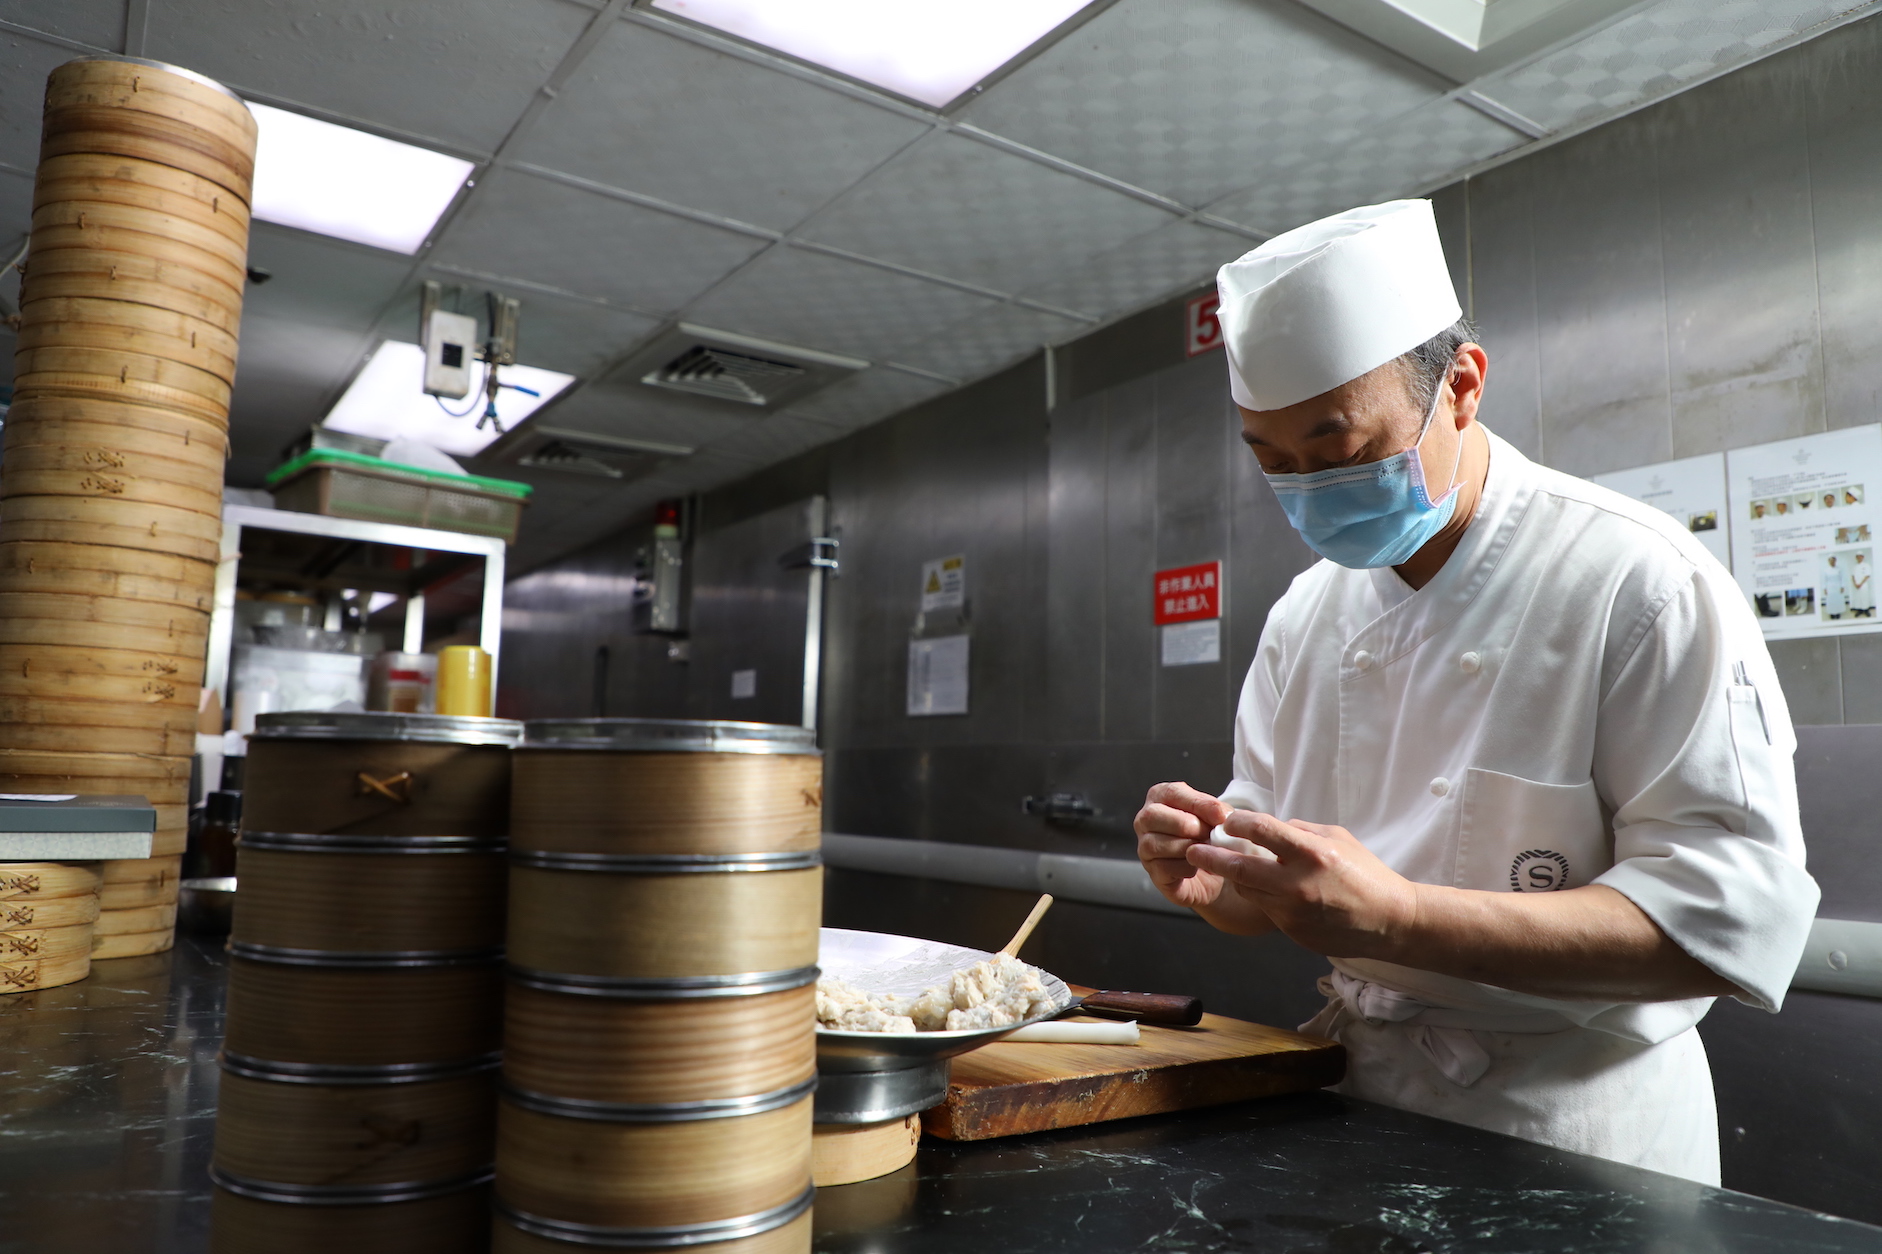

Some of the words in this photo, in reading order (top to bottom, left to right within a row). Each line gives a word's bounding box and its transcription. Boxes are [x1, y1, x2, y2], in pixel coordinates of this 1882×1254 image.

[1196, 299, 1220, 345] 5
[1163, 593, 1210, 615] 禁止進入
[1528, 865, 1554, 889] S
